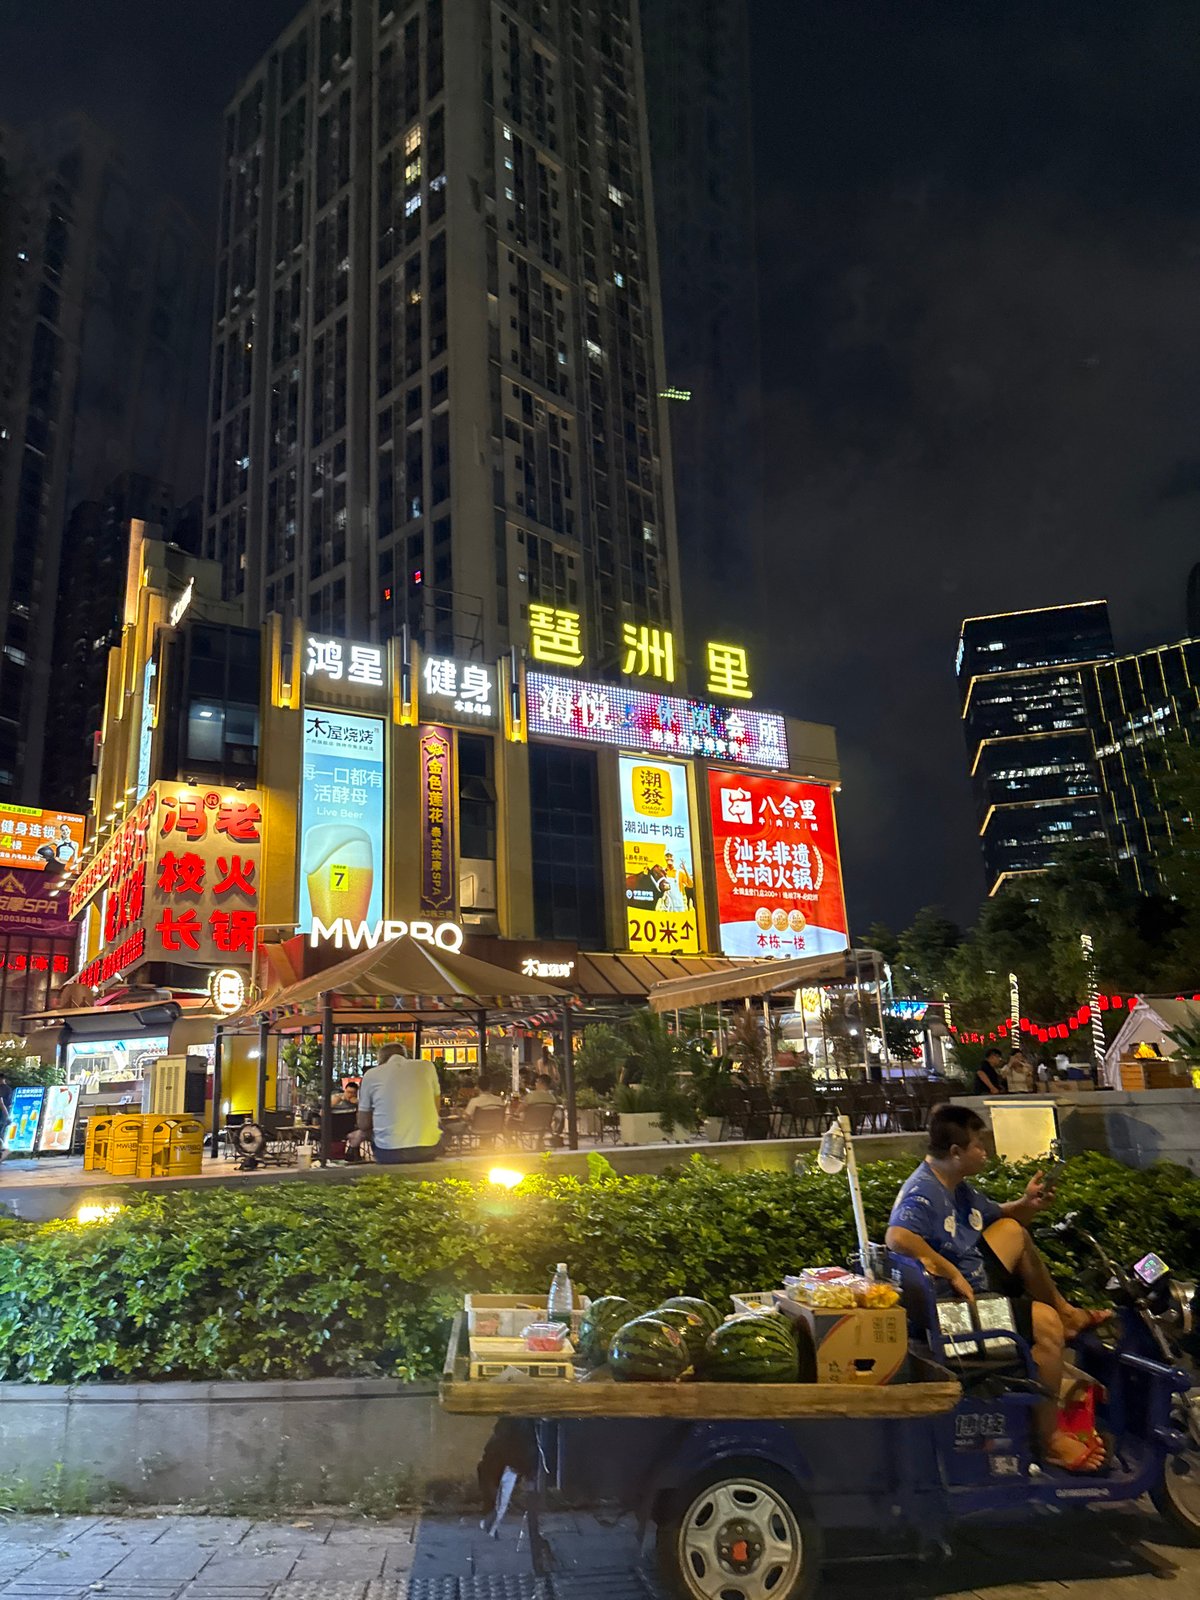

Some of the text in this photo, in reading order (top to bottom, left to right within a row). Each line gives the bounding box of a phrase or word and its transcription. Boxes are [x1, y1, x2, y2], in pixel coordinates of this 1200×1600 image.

[529, 604, 753, 698] 琶洲里
[306, 637, 492, 703] 鸿星 健身
[306, 717, 374, 745] 木屋烧烤
[303, 763, 382, 788] 每一口都有
[314, 784, 368, 806] 活酵母
[316, 807, 364, 819] Live Beer
[758, 796, 817, 820] 八合里
[1, 819, 56, 840] 健身连锁
[624, 820, 685, 838] 潮汕牛肉店
[734, 837, 811, 868] 汕头非遗
[334, 872, 345, 887] 7
[736, 862, 814, 891] 牛肉火锅
[630, 920, 678, 944] 20米
[757, 933, 806, 950] 本栋一楼
